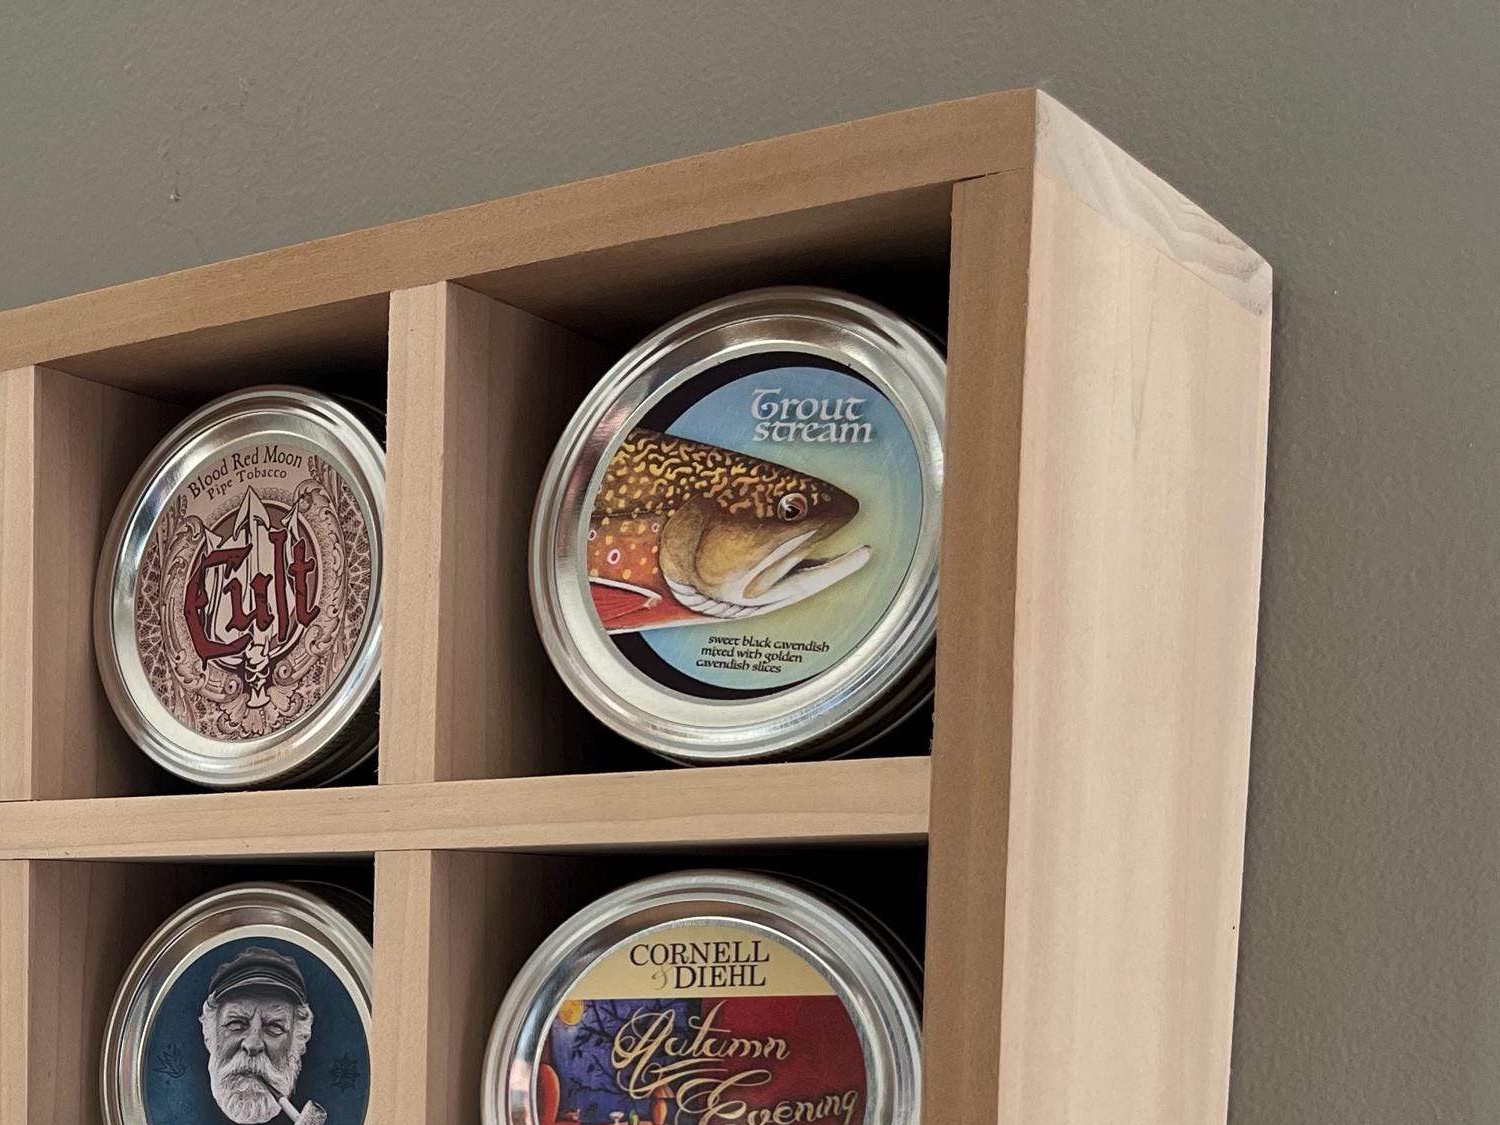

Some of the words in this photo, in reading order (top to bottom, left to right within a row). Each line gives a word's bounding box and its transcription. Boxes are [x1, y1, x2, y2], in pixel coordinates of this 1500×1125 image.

[751, 387, 868, 421] Trout
[187, 458, 228, 499] Blood
[231, 446, 259, 471] Red
[263, 445, 303, 468] Moon
[207, 479, 233, 500] Pipe
[236, 467, 287, 484] Tobacco
[184, 530, 321, 668] Cult
[701, 645, 734, 658] mixed
[736, 648, 762, 659] with
[764, 652, 802, 664] golden
[708, 635, 741, 646] sweet
[742, 635, 771, 648] black
[773, 640, 830, 653] cavendish
[695, 658, 750, 671] cavendish
[752, 662, 782, 673] slices
[629, 940, 770, 967] CORNELL
[673, 964, 767, 990] DIEHL
[610, 1000, 790, 1099] Autumn
